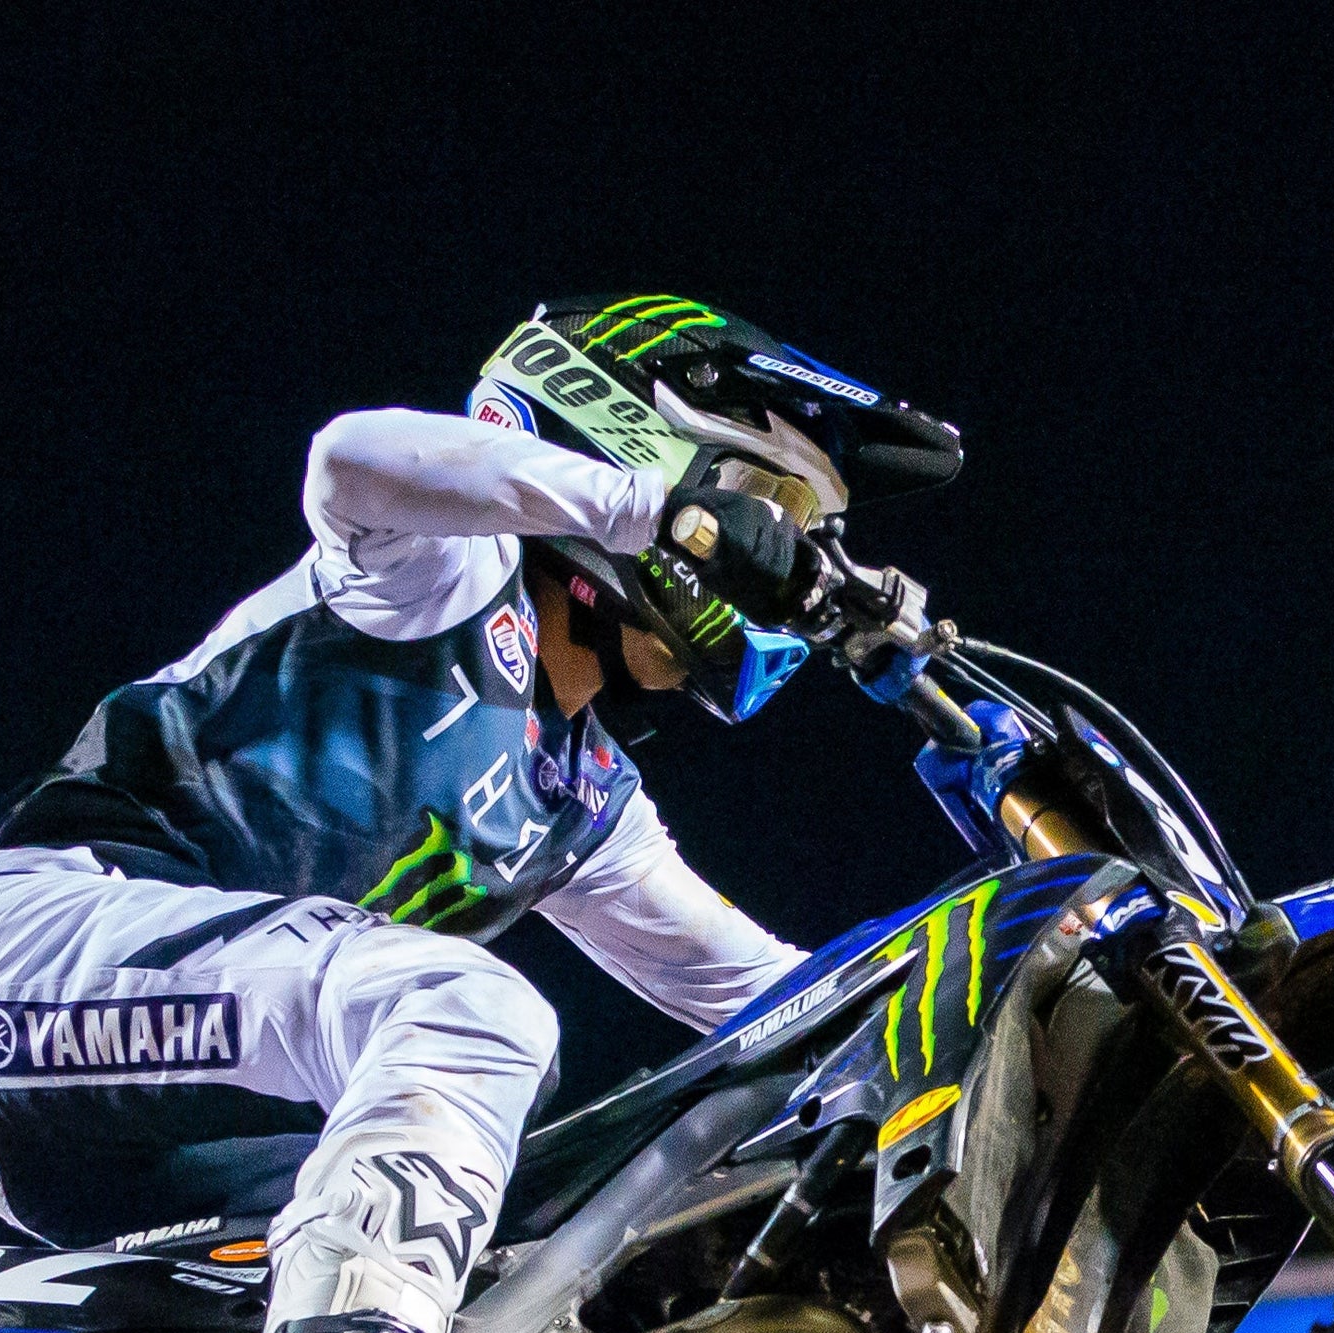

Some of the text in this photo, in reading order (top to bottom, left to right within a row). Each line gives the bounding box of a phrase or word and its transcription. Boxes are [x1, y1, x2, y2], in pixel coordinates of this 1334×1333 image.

[22, 1002, 233, 1067] YAMAHA
[738, 974, 842, 1051] YAMALUBE
[115, 1215, 221, 1253] YAMAHA
